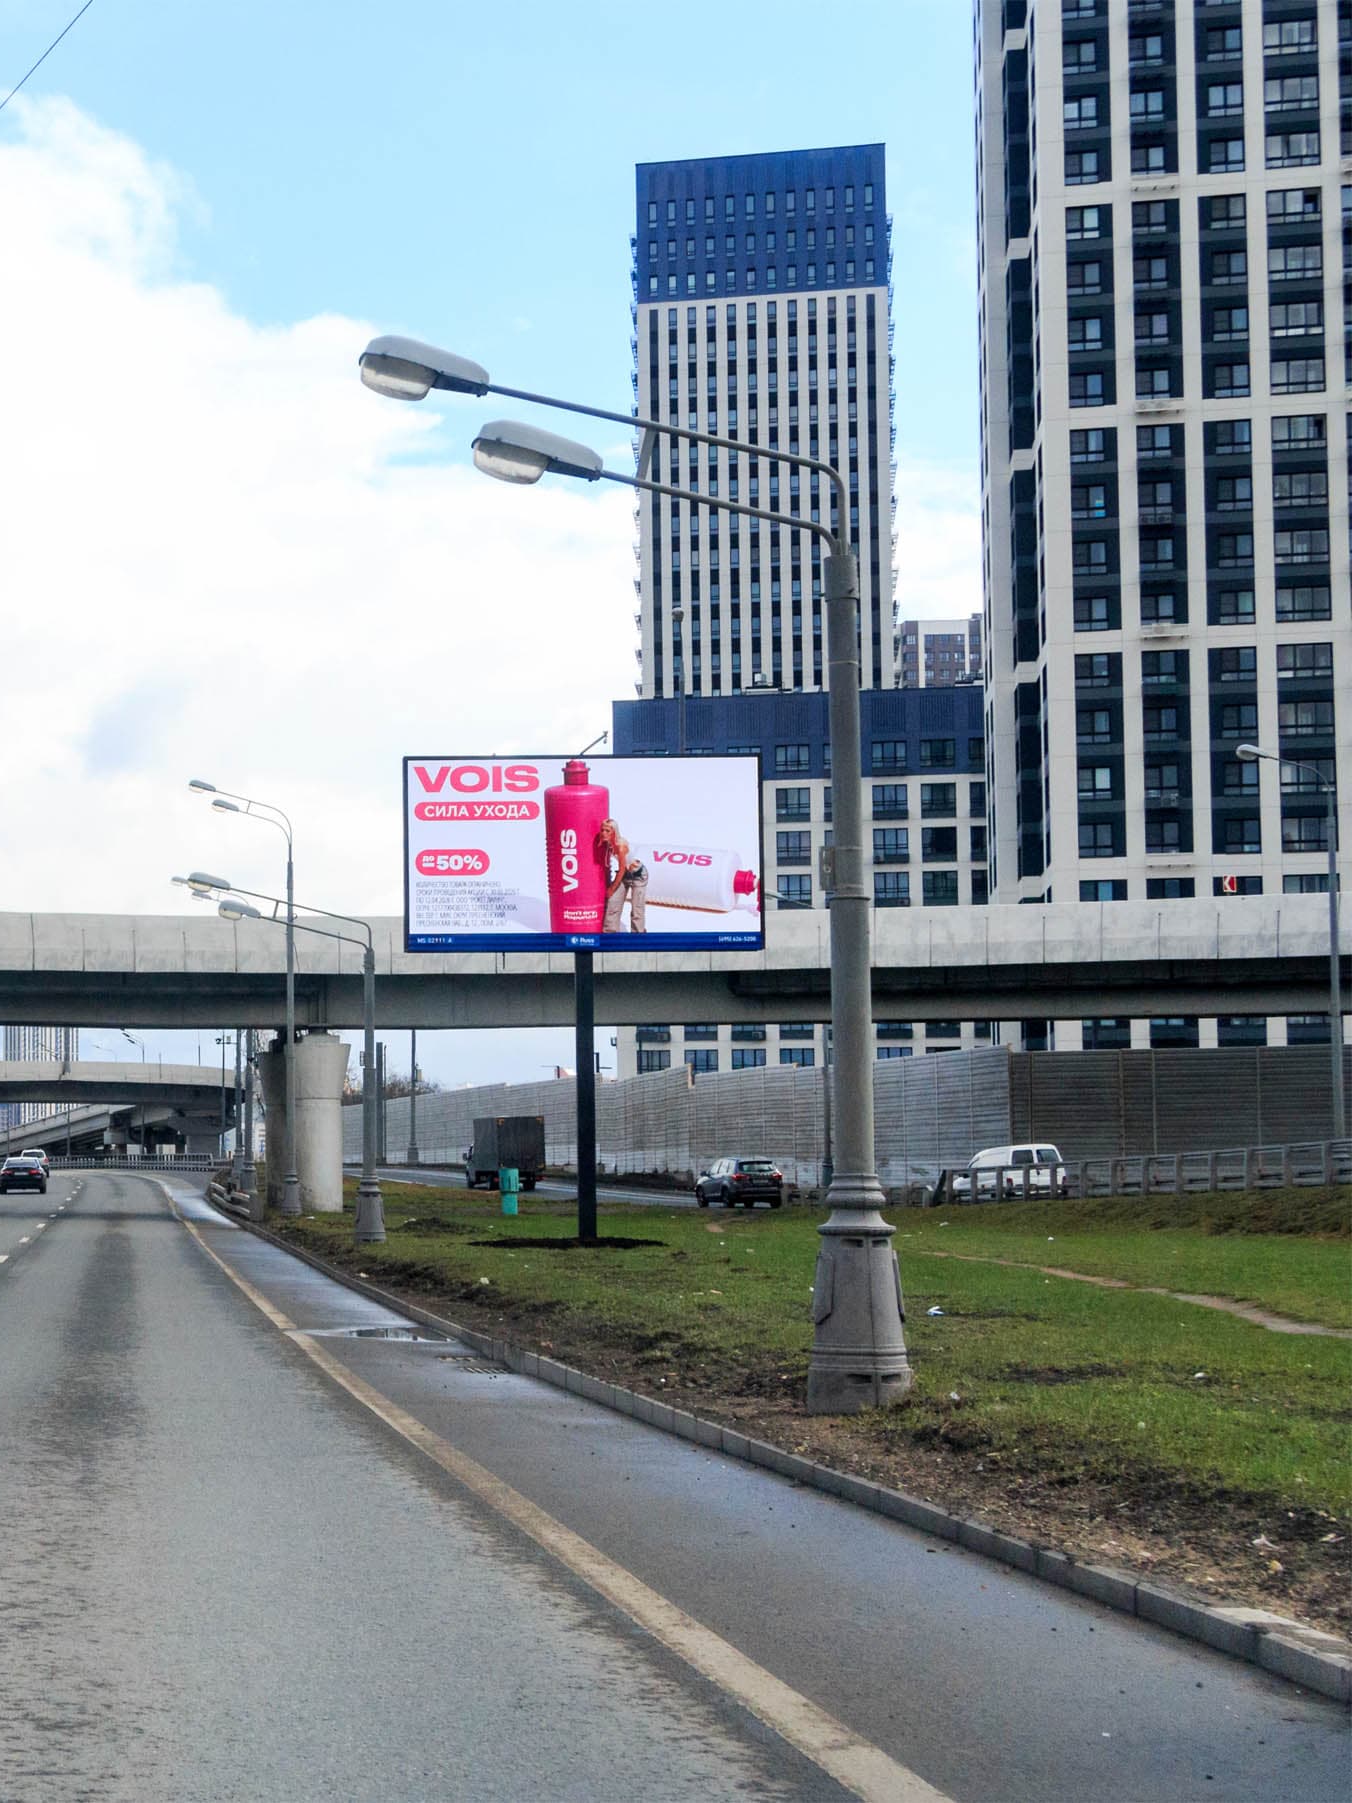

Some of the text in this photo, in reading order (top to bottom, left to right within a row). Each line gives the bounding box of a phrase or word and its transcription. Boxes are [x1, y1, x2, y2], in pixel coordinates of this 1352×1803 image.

[413, 765, 540, 793] VOIS
[424, 804, 530, 819] СИЛА УХОДА
[560, 829, 579, 893] VOIS
[653, 850, 712, 866] VOIS
